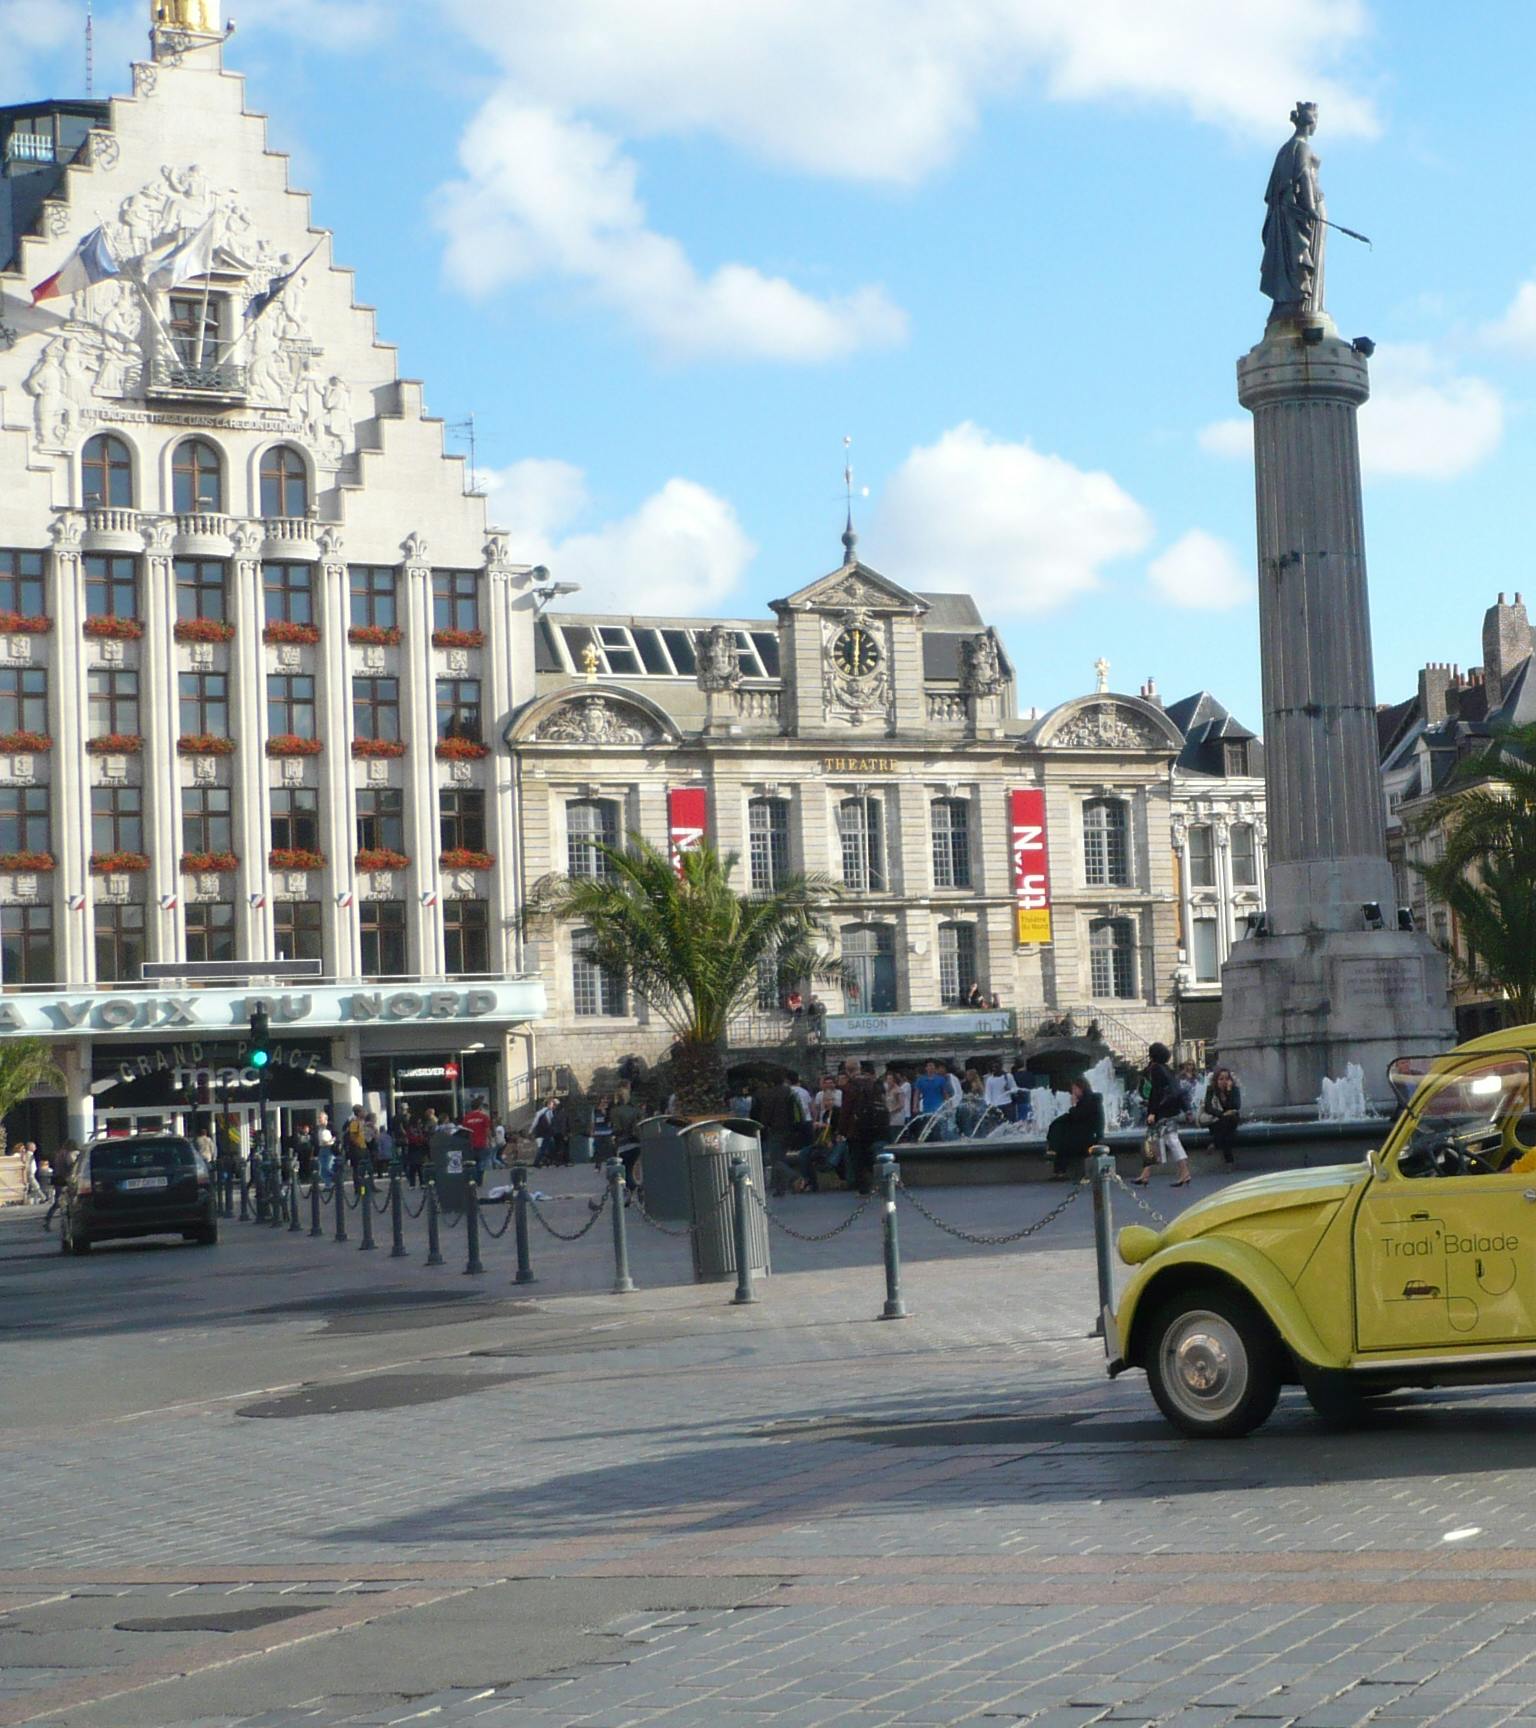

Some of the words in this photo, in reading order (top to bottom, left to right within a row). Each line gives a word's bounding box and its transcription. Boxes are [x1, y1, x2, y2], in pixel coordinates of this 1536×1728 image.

[55, 996, 201, 1025] VOIX
[245, 993, 312, 1020] DU
[352, 989, 498, 1020] NORD
[847, 1018, 888, 1031] SAISON
[238, 1041, 321, 1074] PACE
